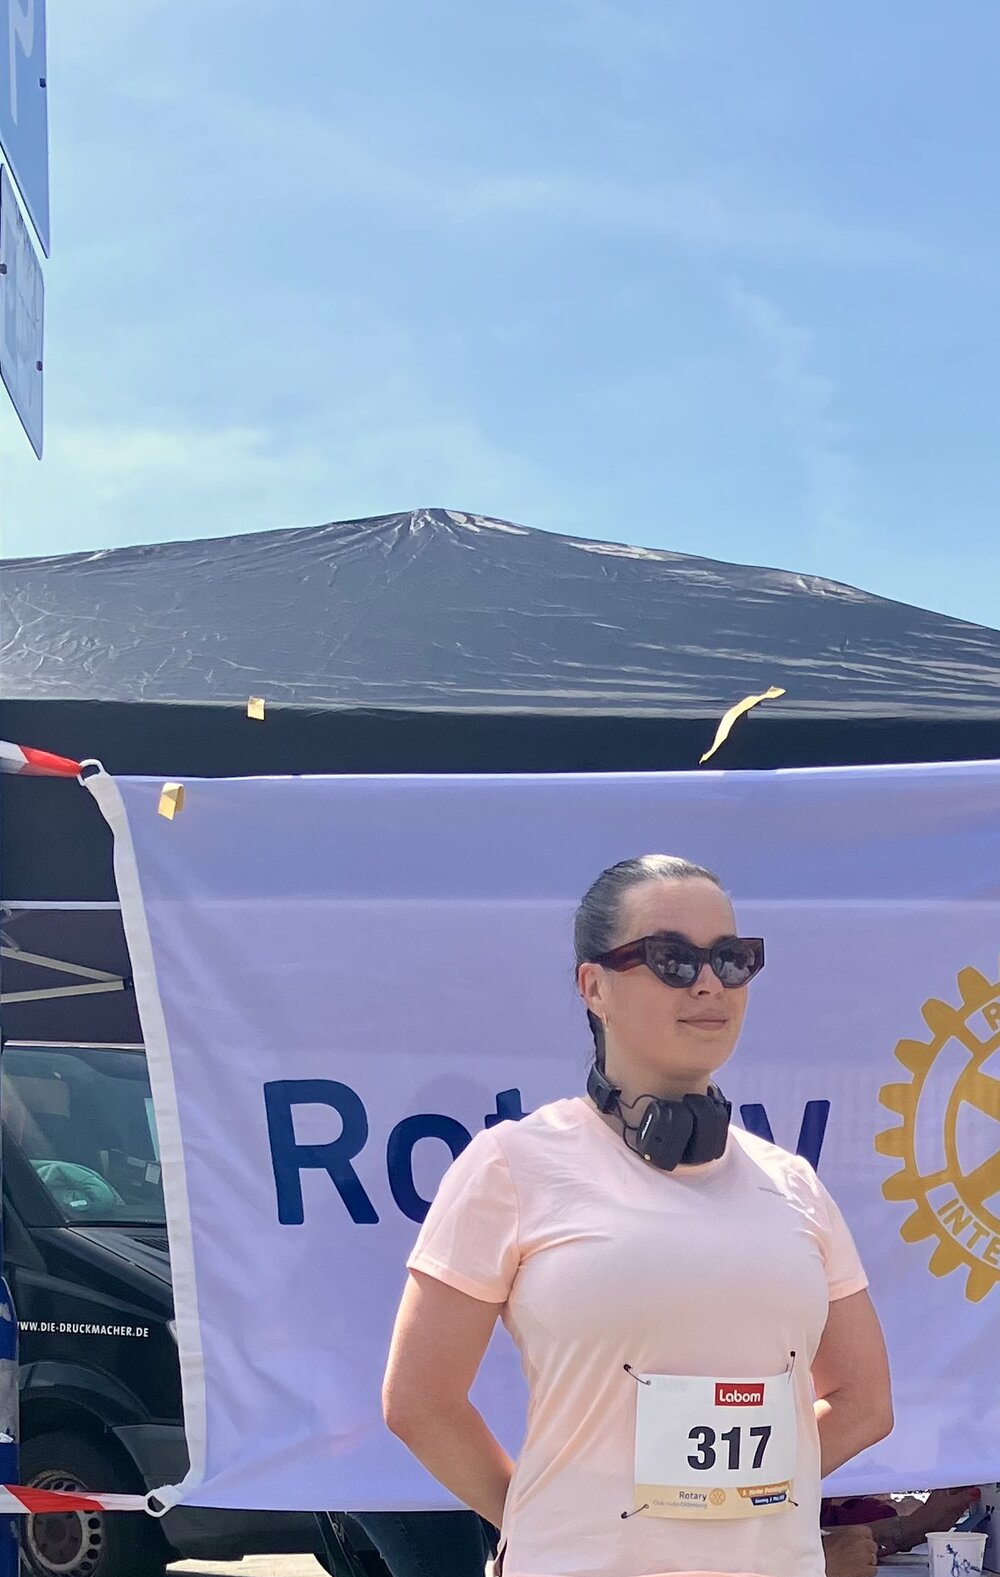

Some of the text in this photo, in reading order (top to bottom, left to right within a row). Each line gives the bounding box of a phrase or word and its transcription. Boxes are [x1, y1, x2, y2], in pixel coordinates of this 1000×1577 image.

[719, 1389, 761, 1403] Labom
[687, 1425, 772, 1470] 317
[679, 1491, 708, 1502] Rotary
